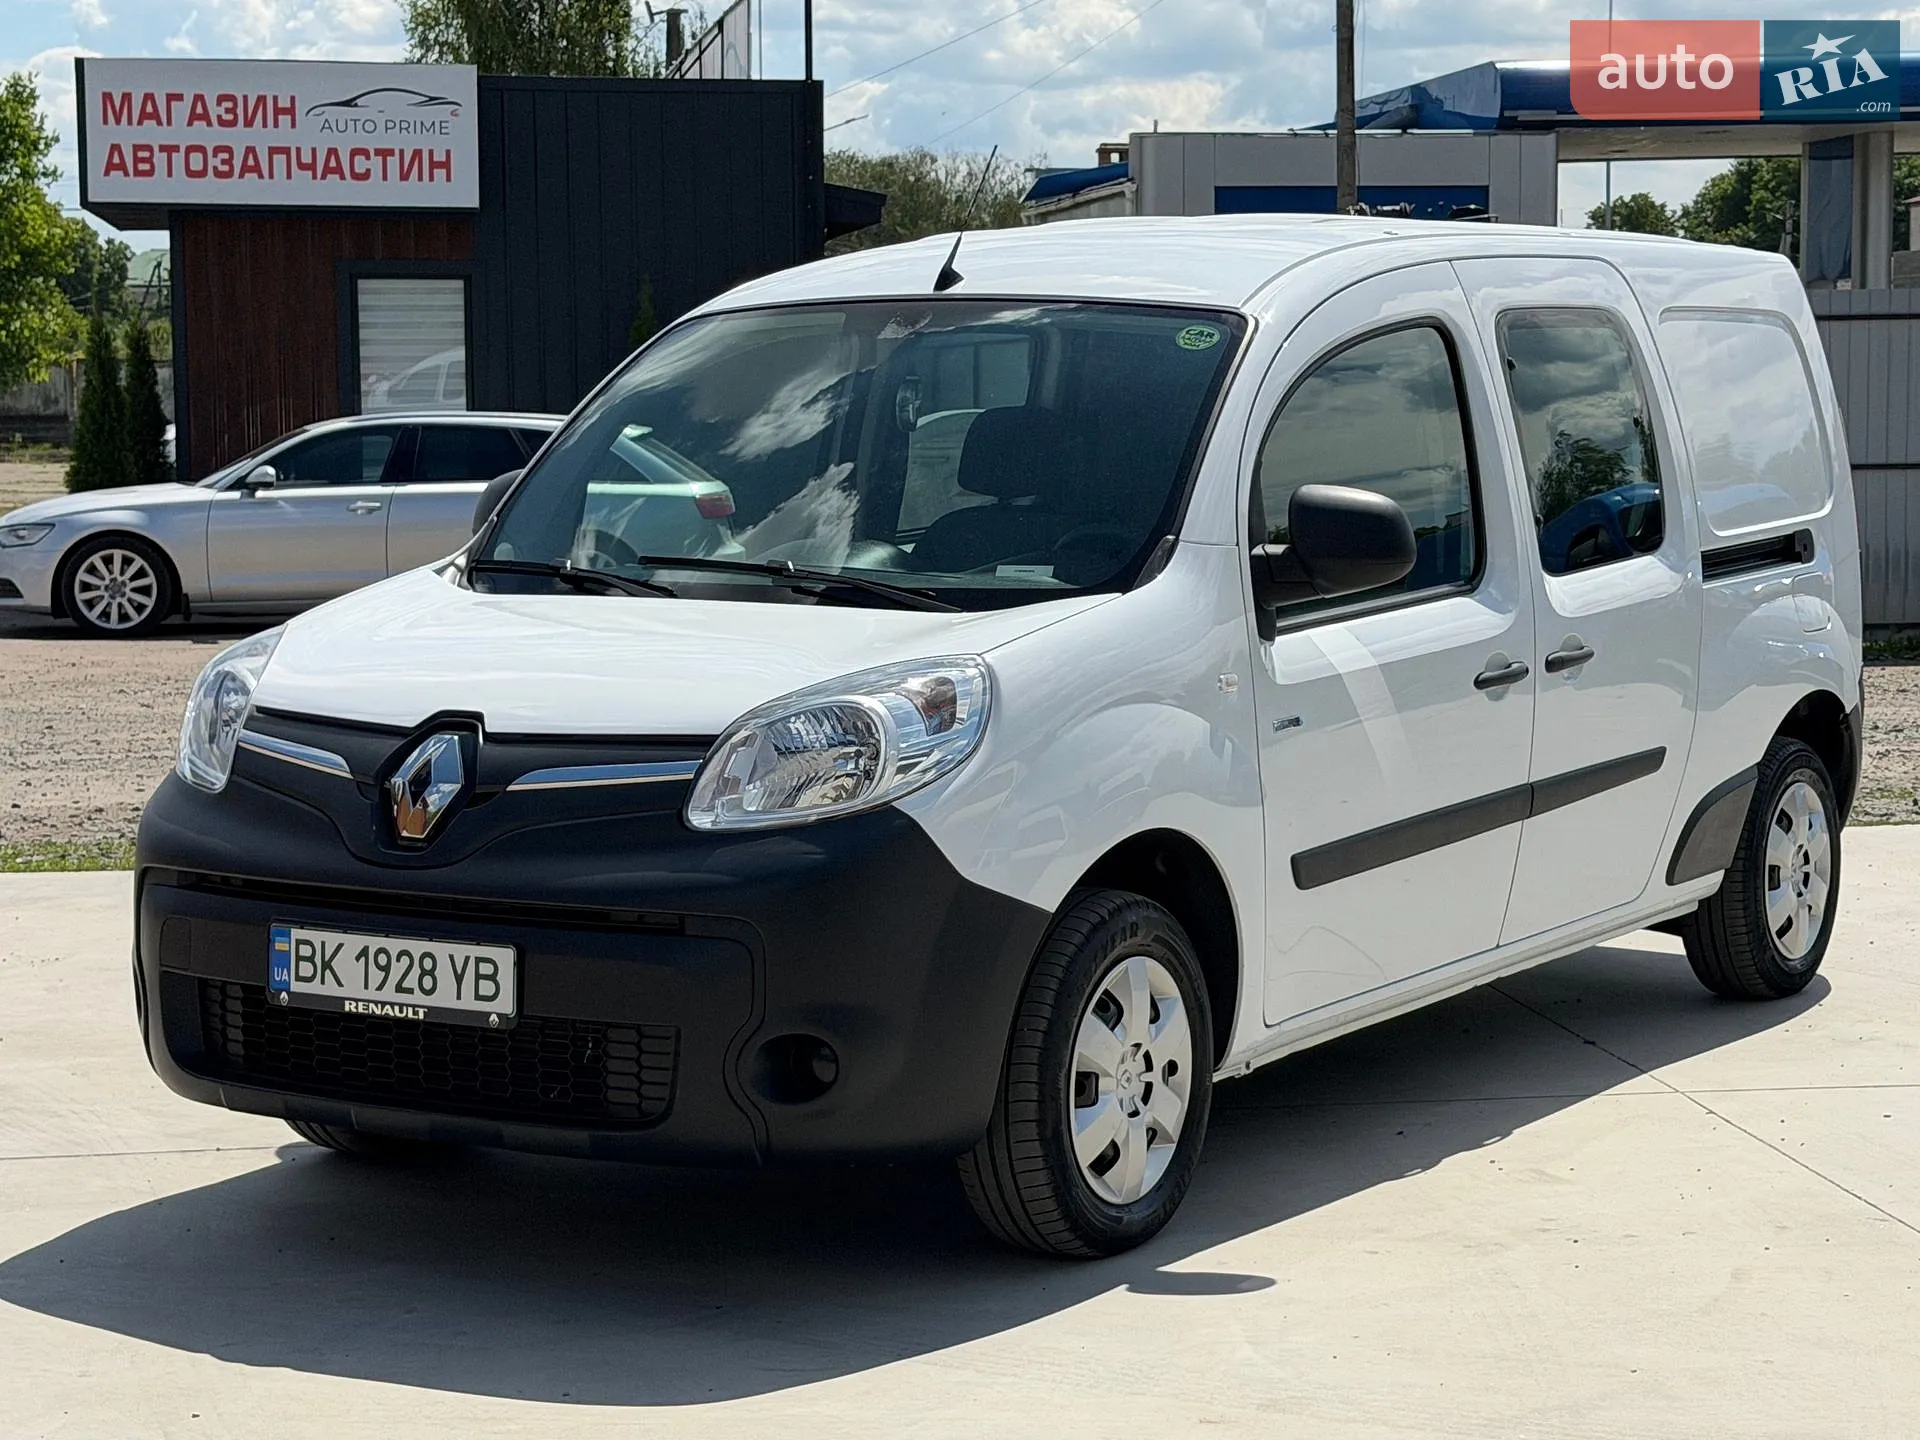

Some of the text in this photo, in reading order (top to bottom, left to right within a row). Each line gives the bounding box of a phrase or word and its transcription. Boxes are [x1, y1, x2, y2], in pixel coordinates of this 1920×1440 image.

[101, 91, 297, 129] МАГАЗИН
[319, 118, 451, 136] AUTO PRIME
[102, 143, 453, 183] АВТОЗАПЧАСТИН
[274, 967, 289, 983] UA
[294, 938, 501, 1002] BK 1928 YB
[344, 1001, 427, 1019] RENAULT
